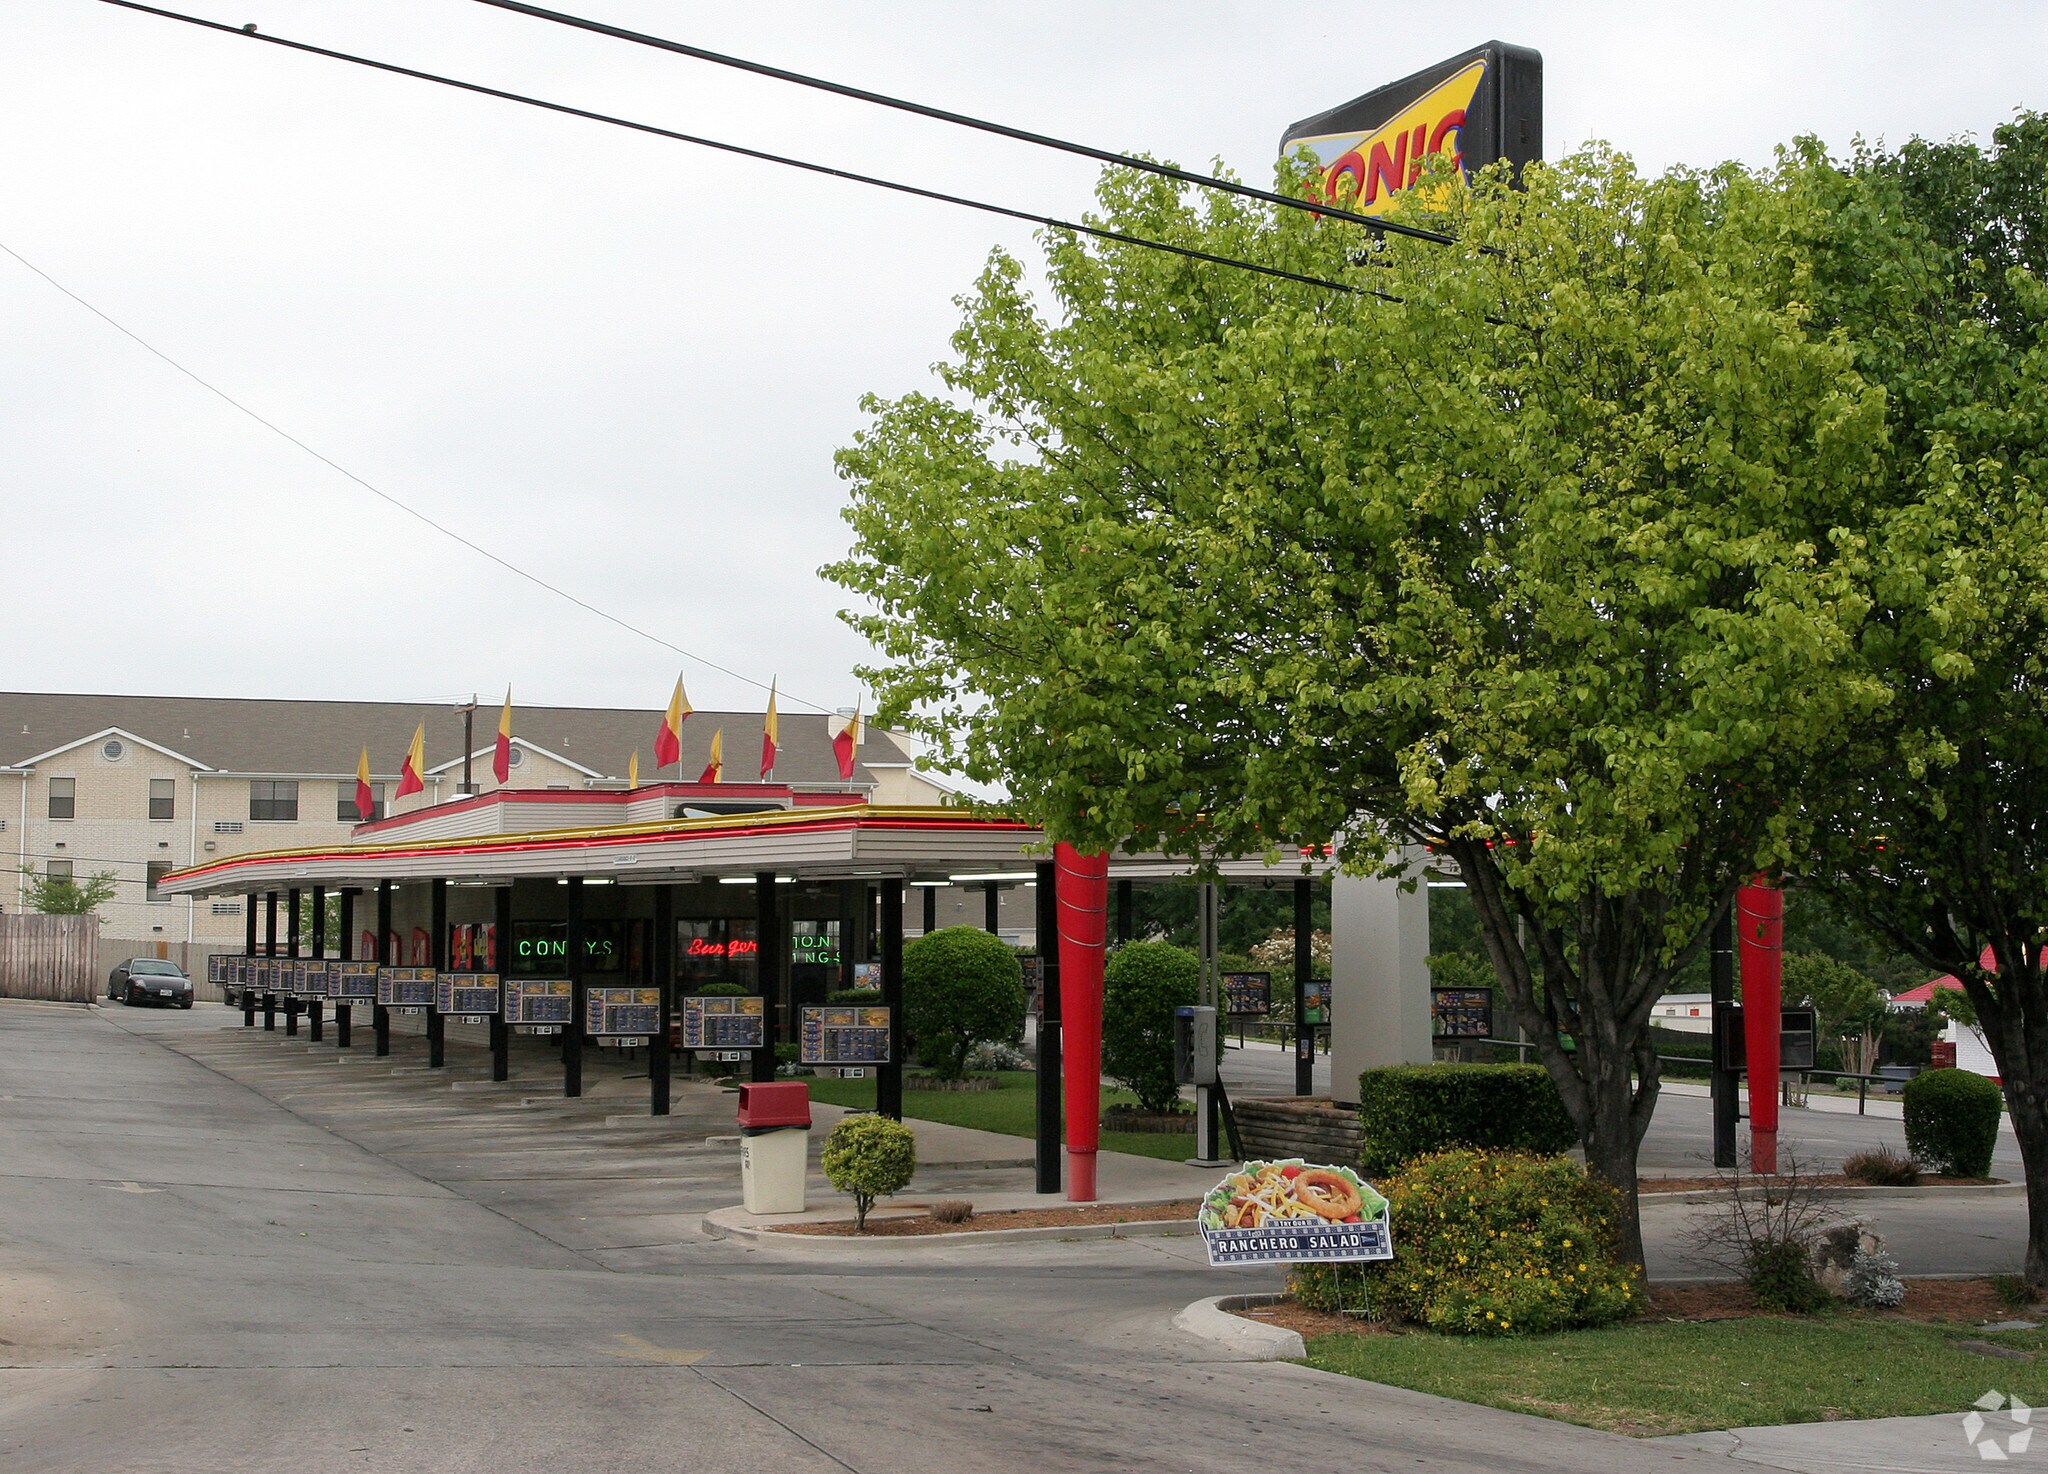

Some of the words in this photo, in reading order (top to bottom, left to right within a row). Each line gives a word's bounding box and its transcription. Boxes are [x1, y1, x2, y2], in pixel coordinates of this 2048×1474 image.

[519, 940, 612, 956] CONYS
[687, 938, 758, 958] Burger
[792, 936, 830, 948] ION
[792, 951, 840, 963] INGS
[1218, 1237, 1298, 1253] RANCHERO
[1309, 1234, 1360, 1249] SALAD
